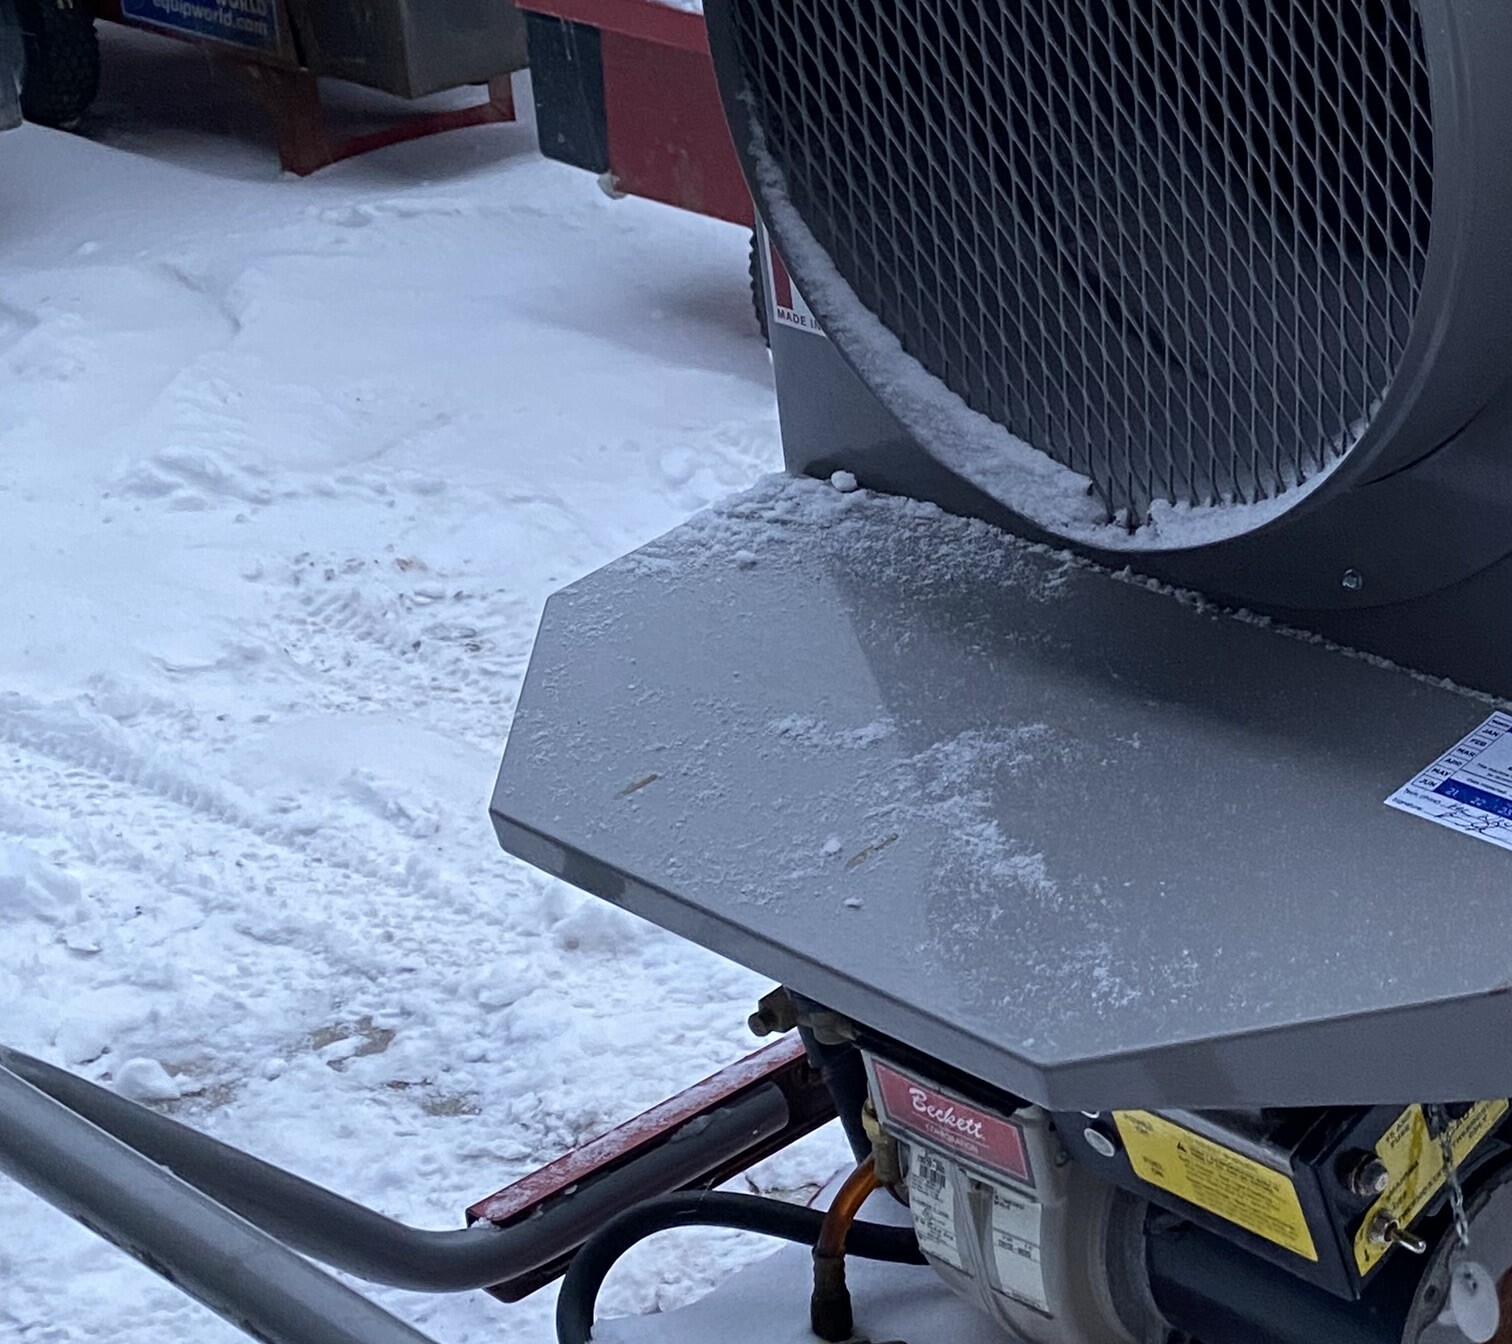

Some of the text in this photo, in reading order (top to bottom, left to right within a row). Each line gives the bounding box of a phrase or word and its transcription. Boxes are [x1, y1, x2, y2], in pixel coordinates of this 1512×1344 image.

[777, 308, 807, 325] MADE
[1480, 727, 1501, 737] JAN
[1468, 737, 1488, 747] FEB
[1455, 746, 1477, 757] MAR
[1430, 766, 1451, 777] MAY
[1418, 777, 1438, 787] JUN
[909, 1087, 982, 1139] Beckett
